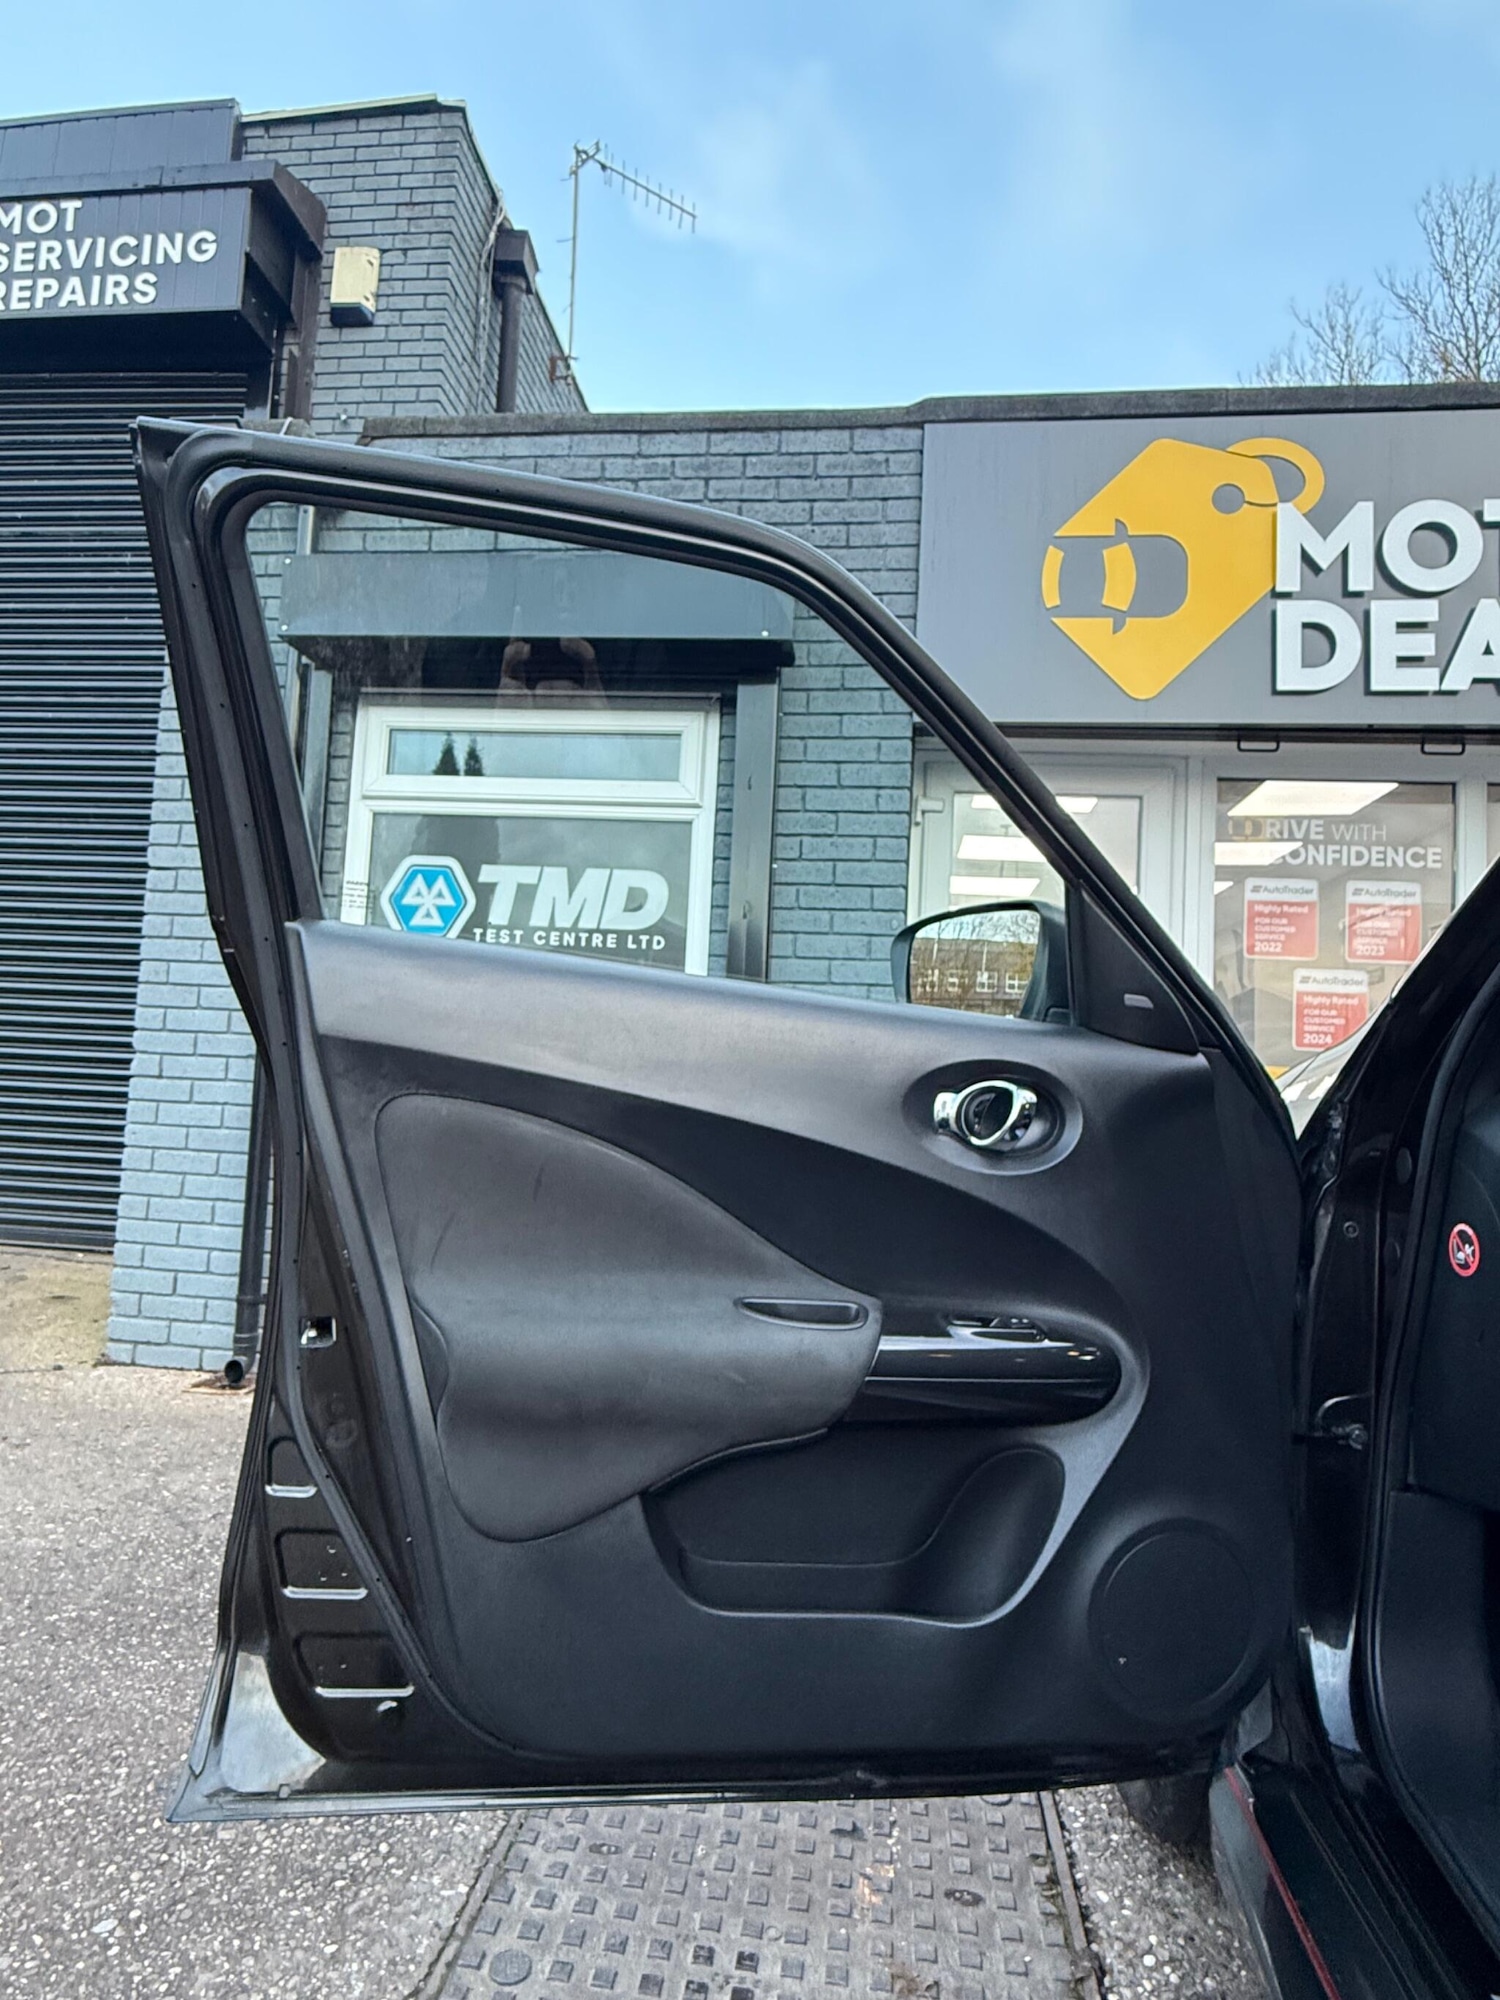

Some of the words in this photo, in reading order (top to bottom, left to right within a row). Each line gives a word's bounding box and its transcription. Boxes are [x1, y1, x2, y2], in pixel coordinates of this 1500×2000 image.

[0, 200, 82, 235] MOT
[0, 271, 159, 311] EPAIRS
[1275, 498, 1500, 594] MO
[1273, 598, 1500, 694] DEA
[1331, 823, 1387, 841] WITH
[1272, 843, 1443, 869] ONFIDENCE
[477, 863, 669, 930] TMD
[1262, 885, 1314, 895] AutoTrader
[1282, 905, 1309, 914] Rated
[473, 928, 524, 945] TEST
[533, 930, 618, 949] CENTRE
[627, 935, 666, 950] LTD
[1254, 941, 1283, 953] 2022
[1356, 945, 1385, 956] 2023
[1311, 976, 1364, 986] AutoTrader
[1332, 996, 1359, 1006] Rated
[1303, 1033, 1333, 1045] 2024
